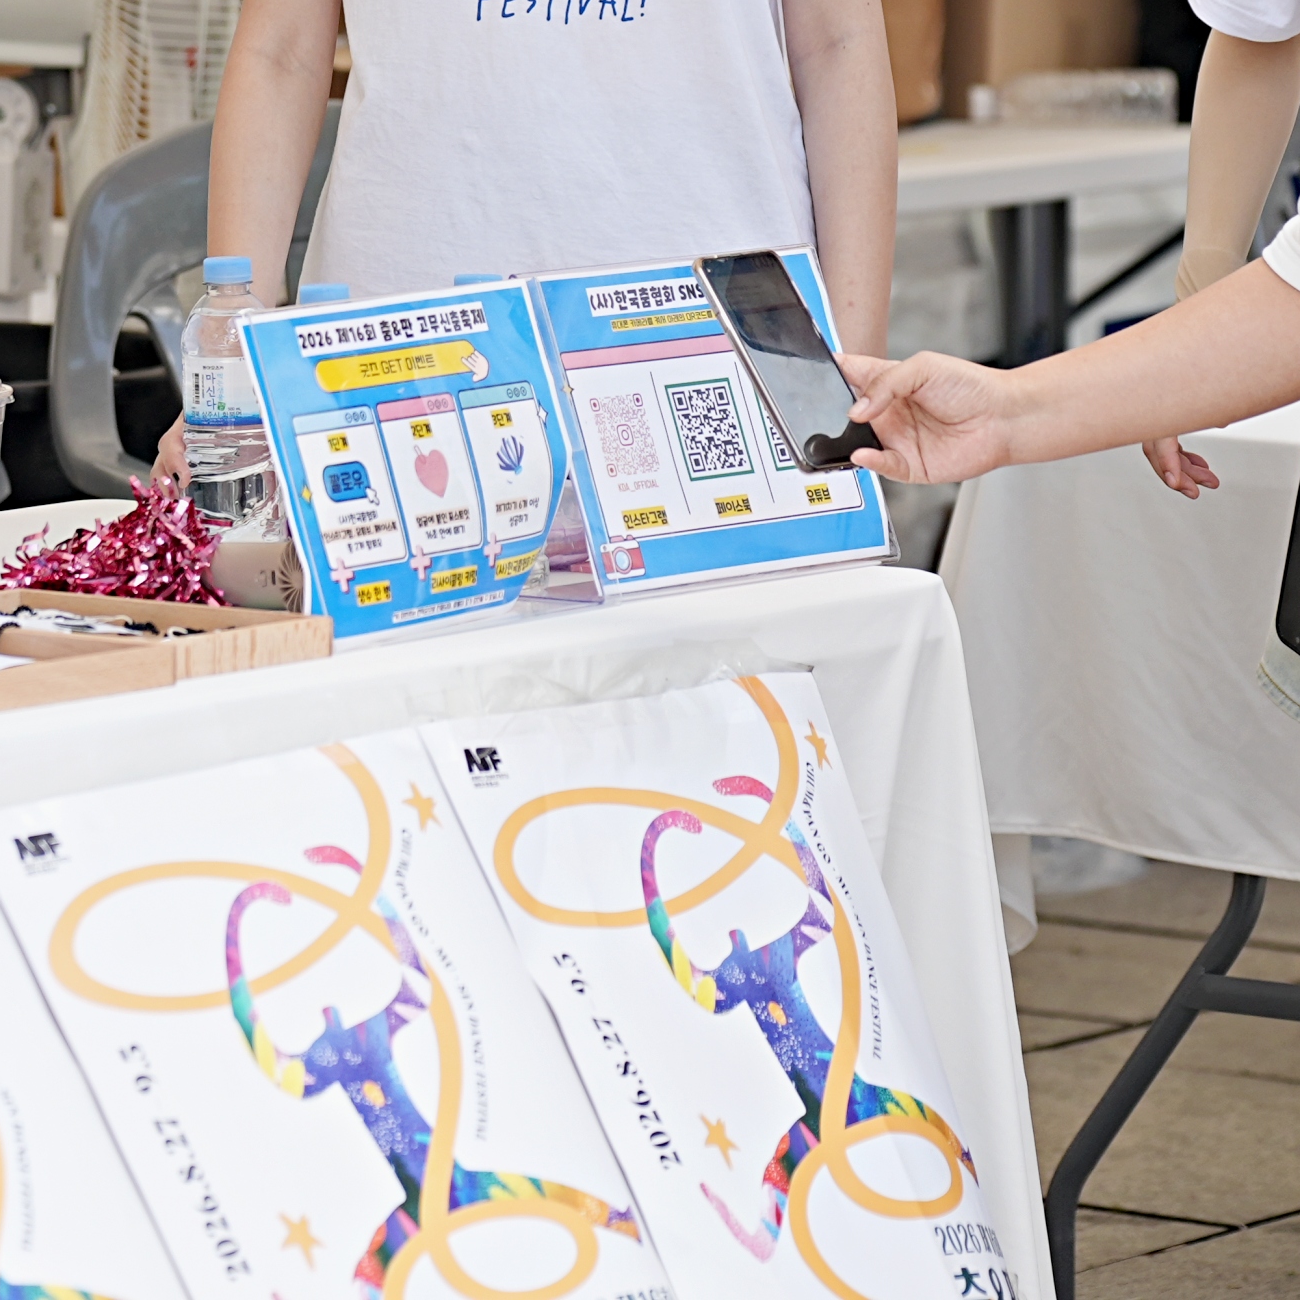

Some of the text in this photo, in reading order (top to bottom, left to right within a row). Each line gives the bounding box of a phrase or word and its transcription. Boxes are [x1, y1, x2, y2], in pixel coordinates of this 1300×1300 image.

[590, 283, 705, 311] (사)한국춤협회 SNS
[298, 308, 486, 349] 2026 제16회 춤&판 고무신춤축제
[381, 358, 403, 374] GET
[405, 354, 436, 371] 이벤트
[206, 372, 216, 410] 마신다
[491, 411, 512, 427] 3단계
[411, 422, 432, 438] 2단계
[328, 469, 365, 494] 팔로우
[807, 488, 831, 502] 유튜브
[715, 498, 752, 514] 페이스북
[623, 512, 668, 529] 인스타그램
[432, 572, 464, 588] 리사이클링
[357, 589, 372, 604] 생수
[816, 841, 831, 864] GO
[864, 942, 877, 989] DANCE
[869, 989, 883, 1061] FESTIVAL
[935, 1224, 981, 1256] 2026
